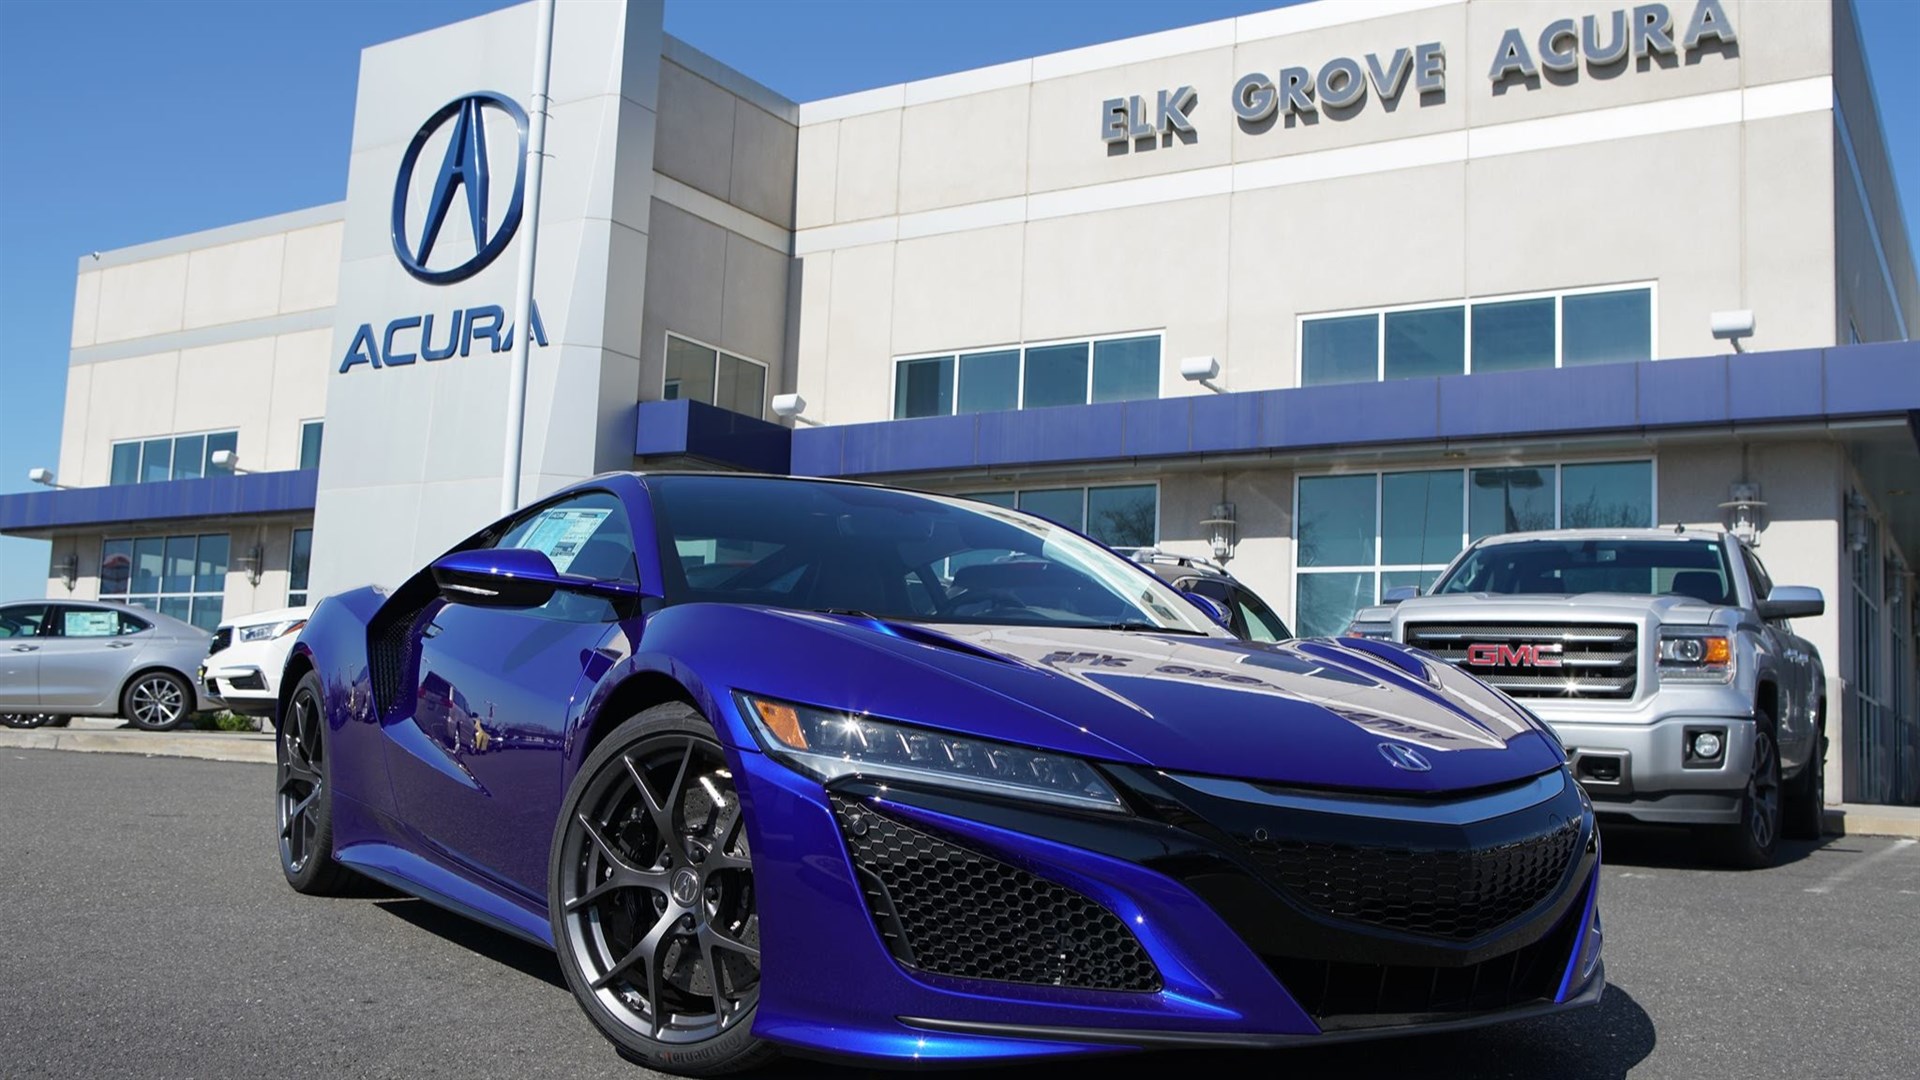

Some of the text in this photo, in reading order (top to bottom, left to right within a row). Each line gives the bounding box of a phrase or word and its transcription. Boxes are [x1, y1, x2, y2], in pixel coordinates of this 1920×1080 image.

[1101, 0, 1738, 143] ELK GROVE ACURA
[339, 298, 549, 373] ACURA
[1467, 643, 1563, 667] GMC
